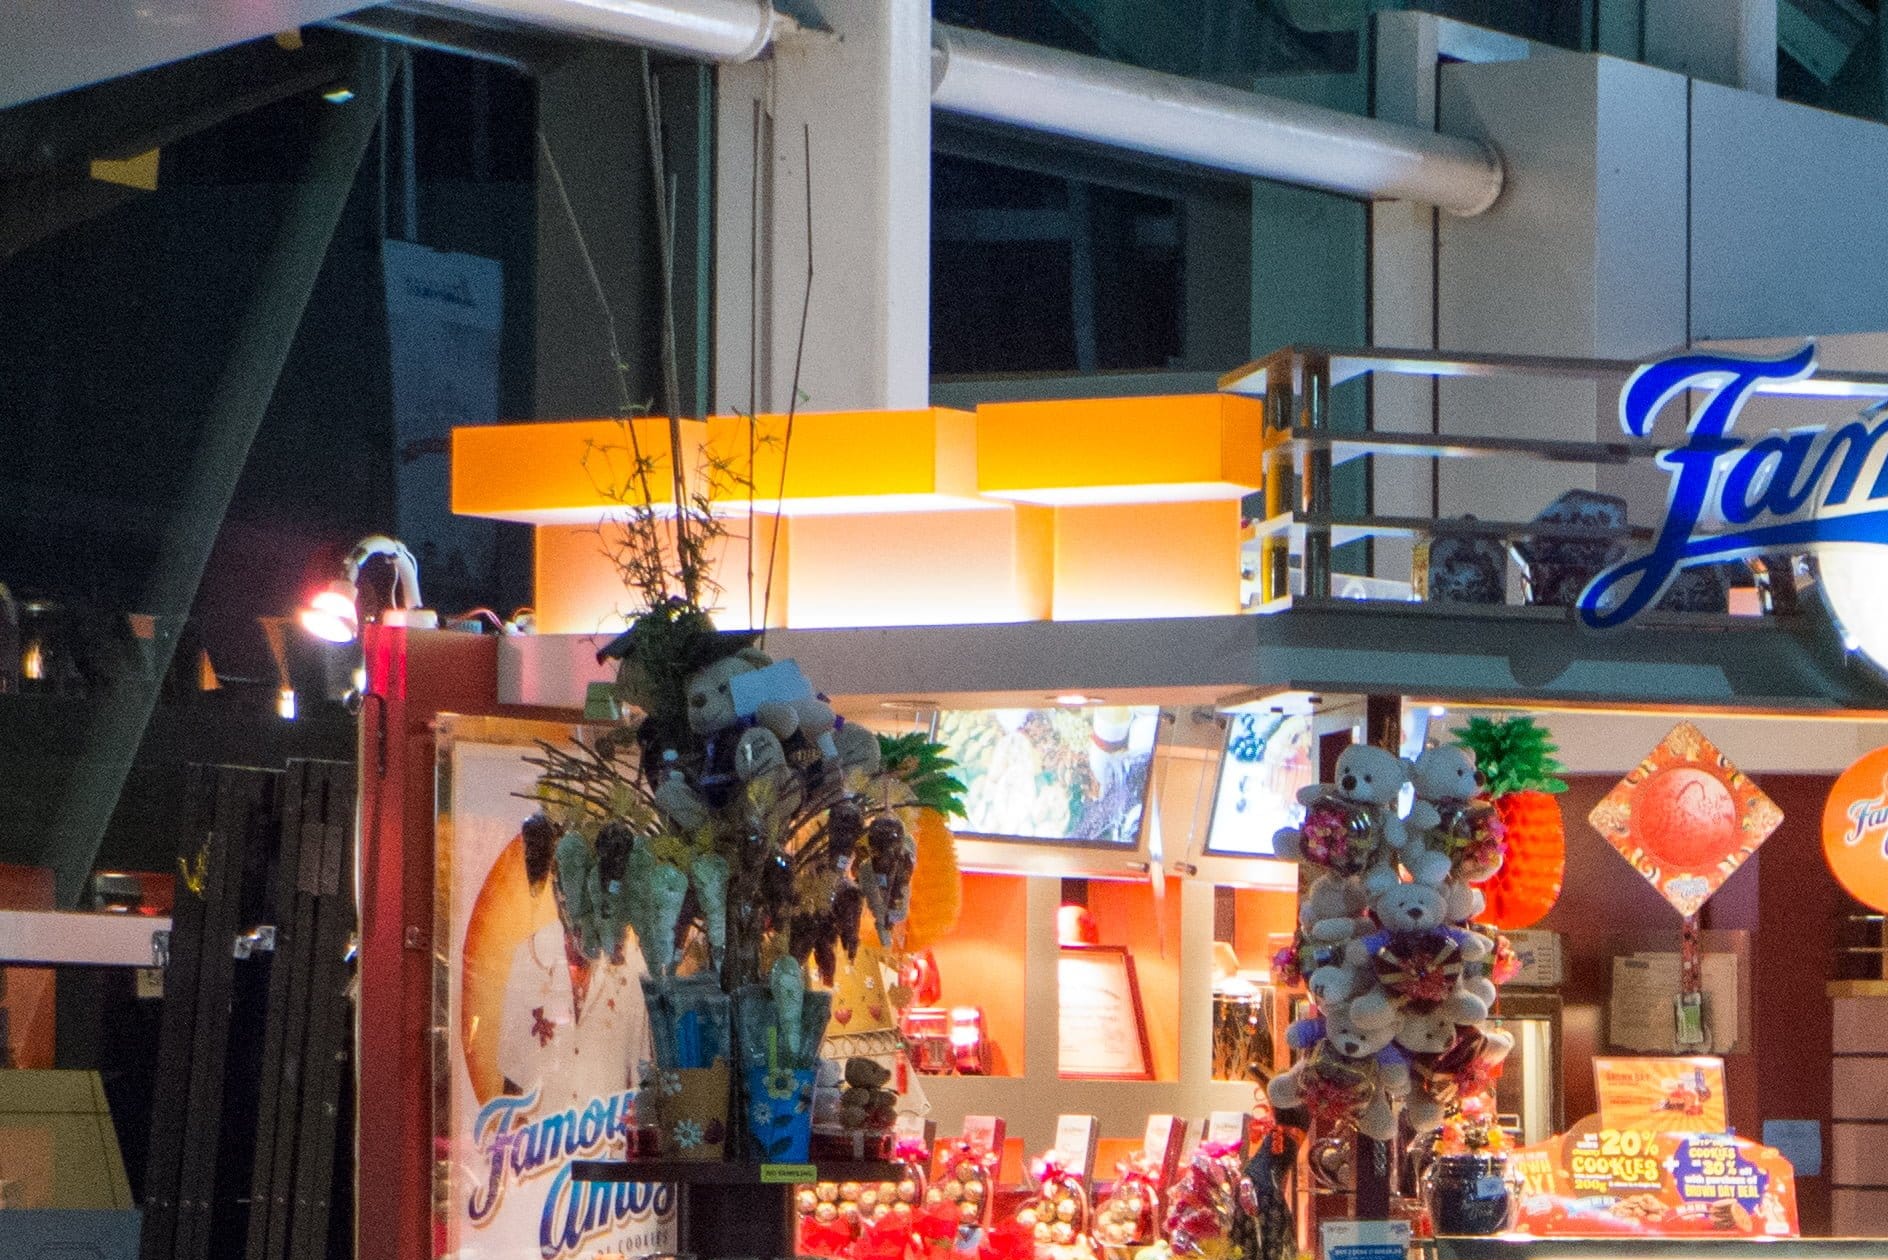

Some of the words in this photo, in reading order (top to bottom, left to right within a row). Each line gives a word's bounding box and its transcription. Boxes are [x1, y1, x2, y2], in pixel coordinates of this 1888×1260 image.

[468, 1086, 640, 1222] Famou
[1599, 1128, 1660, 1156] 20%
[1688, 1147, 1737, 1160] COOKIES
[1571, 1155, 1660, 1182] COOKIES
